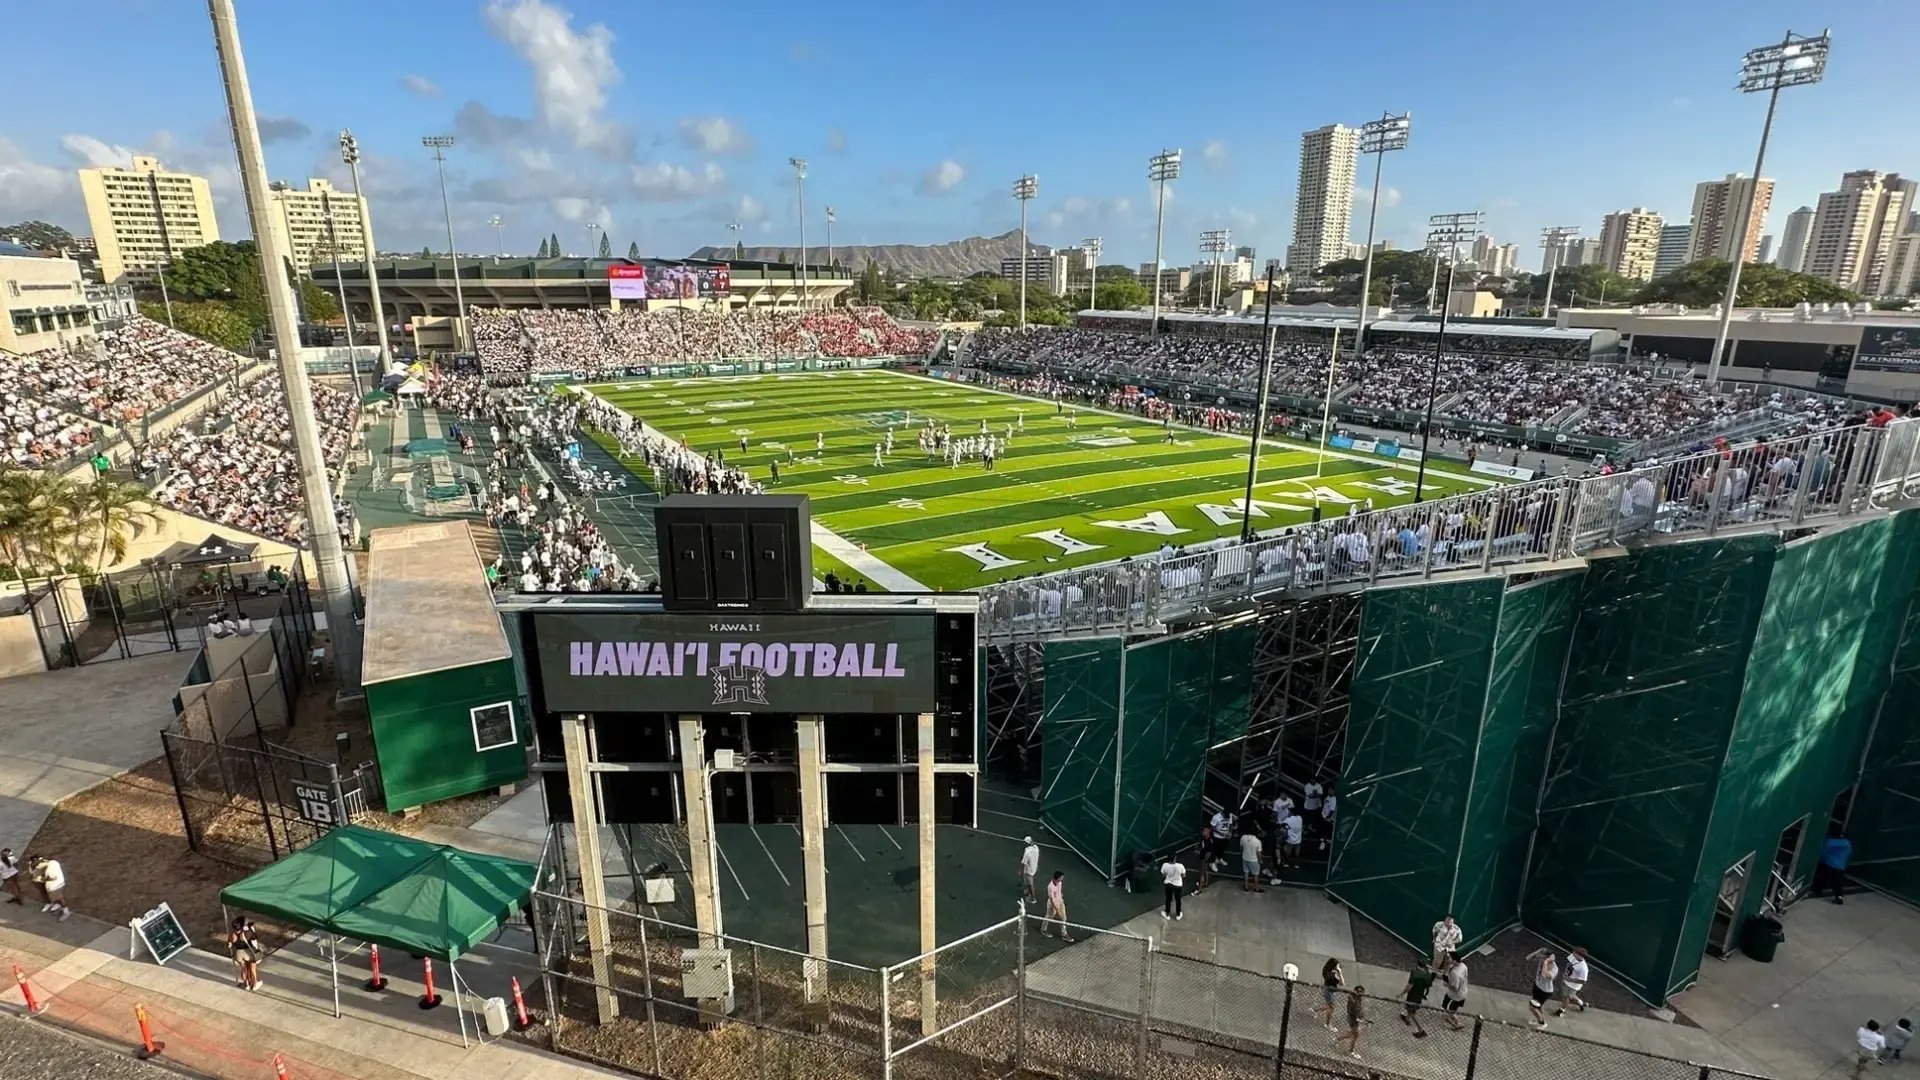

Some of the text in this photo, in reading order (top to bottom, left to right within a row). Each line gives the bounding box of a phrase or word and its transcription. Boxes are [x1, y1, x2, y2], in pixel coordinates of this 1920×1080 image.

[719, 642, 905, 677] FOOTBALL
[296, 786, 328, 802] GATE
[300, 799, 331, 822] 1B
